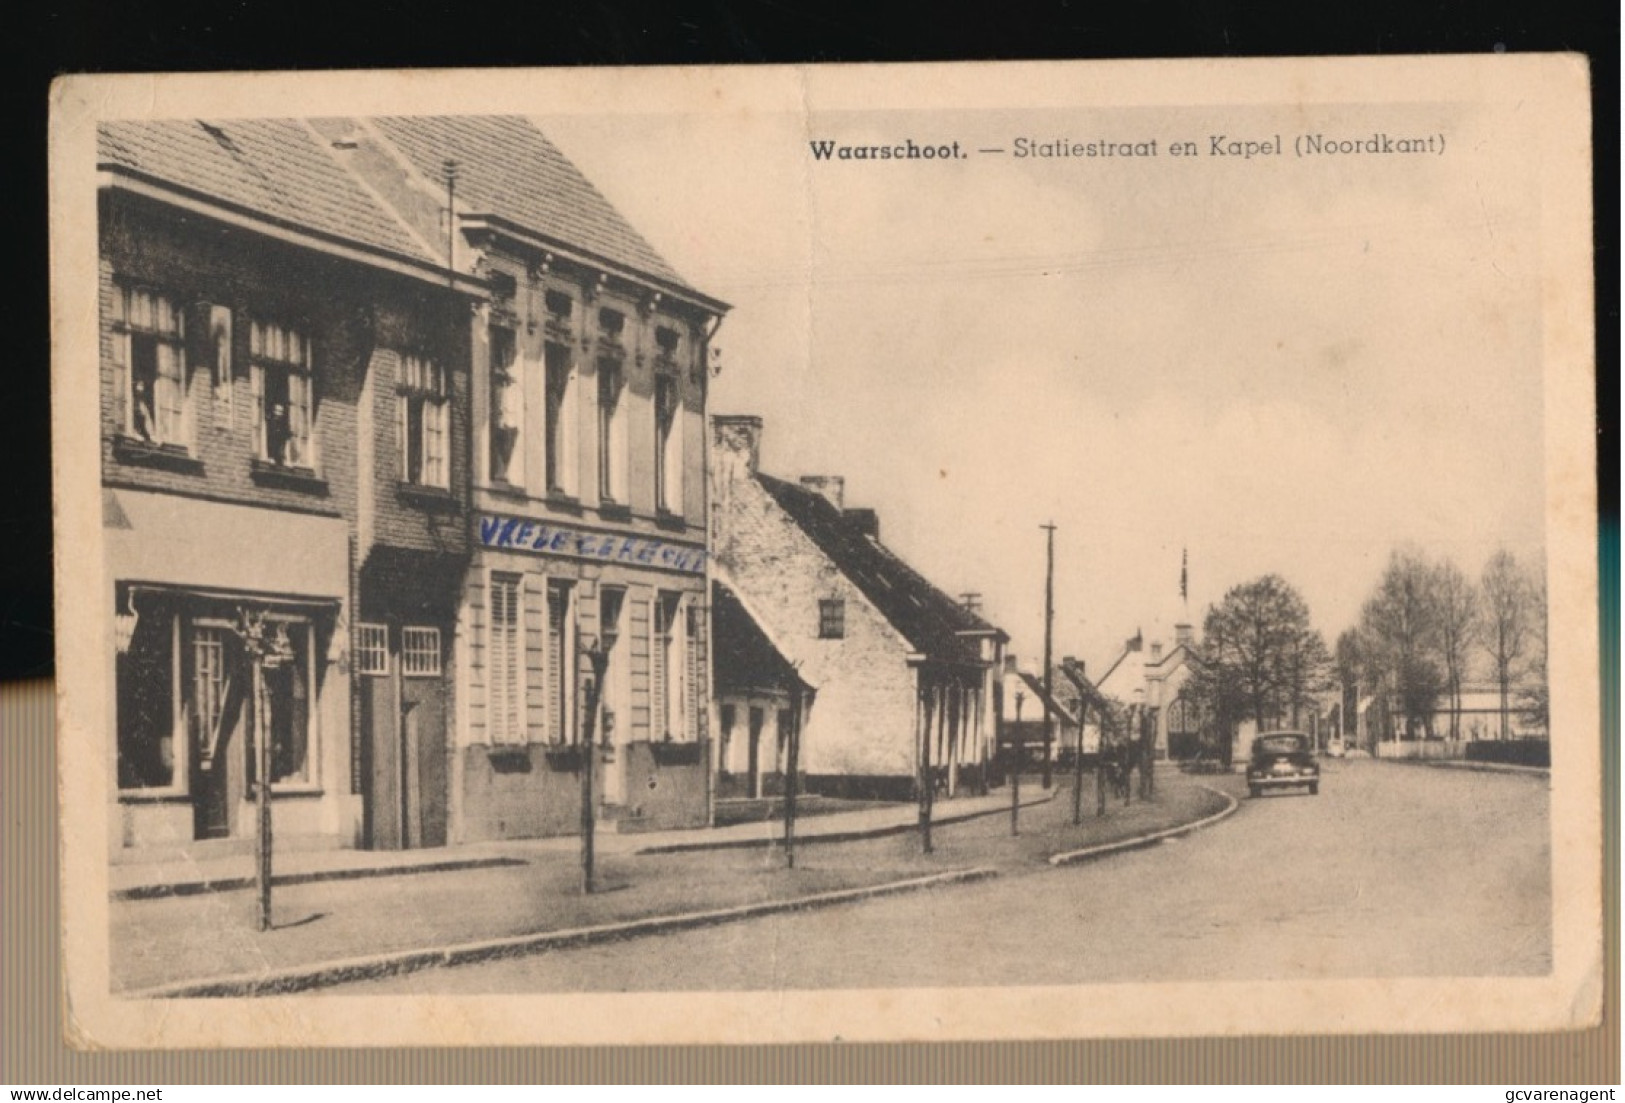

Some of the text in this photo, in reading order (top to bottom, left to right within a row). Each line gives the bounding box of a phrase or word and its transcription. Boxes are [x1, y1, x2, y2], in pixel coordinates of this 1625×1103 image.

[809, 139, 968, 161] Waarschoot.
[1013, 137, 1158, 158] Statiestraat
[1168, 141, 1198, 156] en
[1209, 134, 1282, 160] Kapel
[1295, 133, 1446, 158] (Noordkant)
